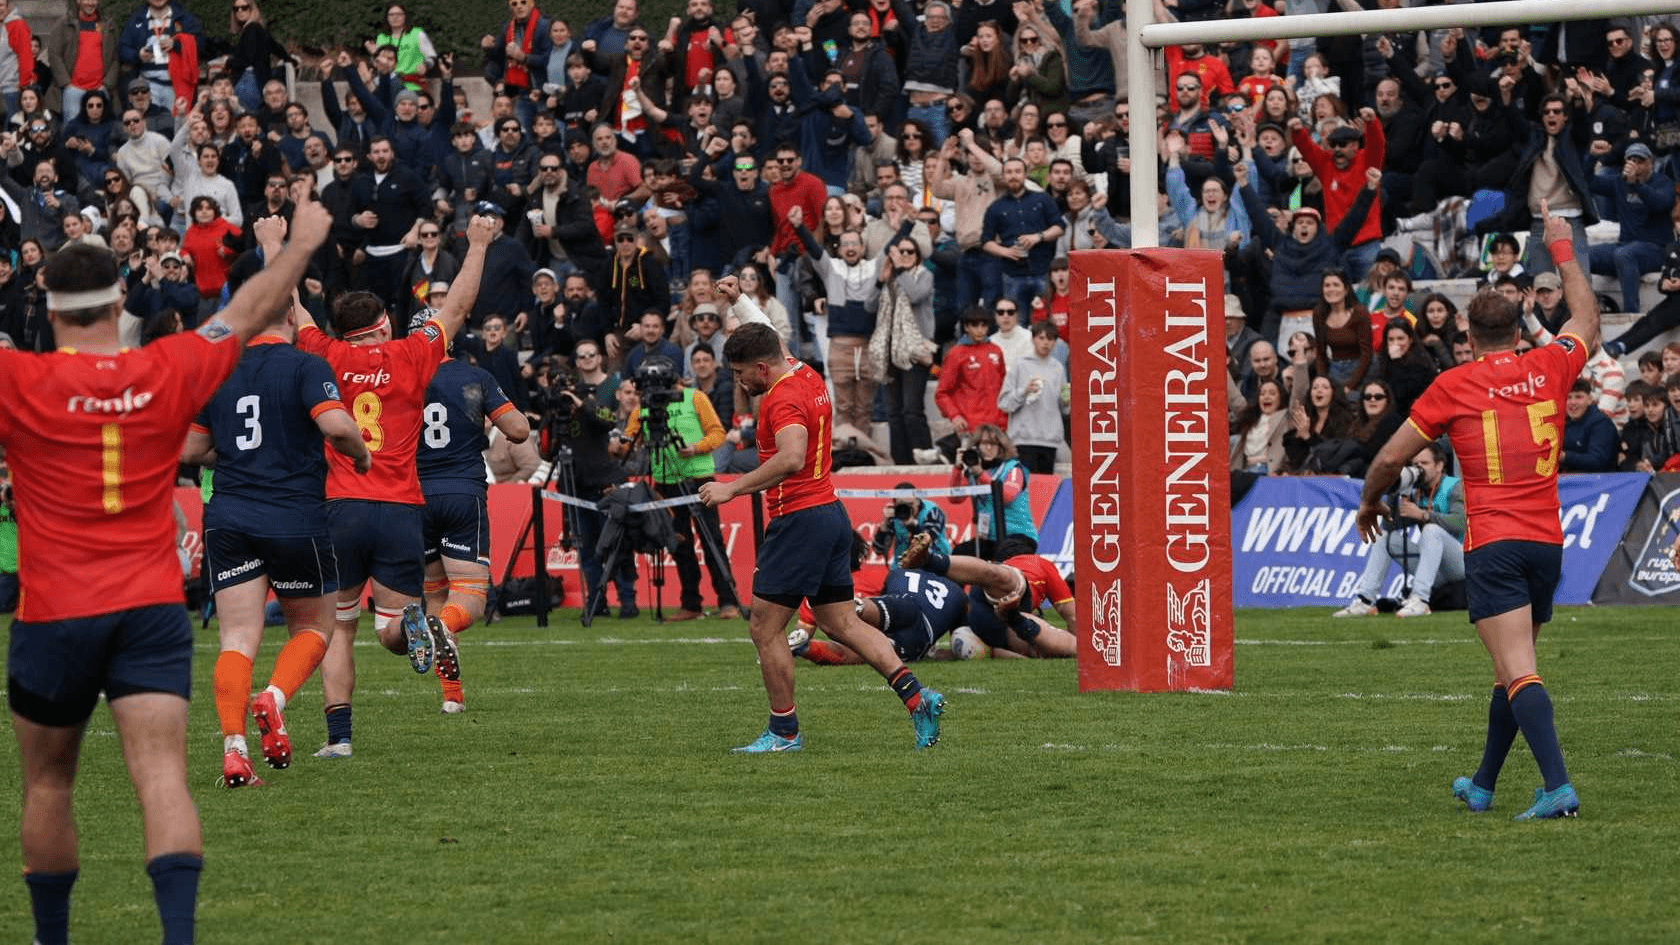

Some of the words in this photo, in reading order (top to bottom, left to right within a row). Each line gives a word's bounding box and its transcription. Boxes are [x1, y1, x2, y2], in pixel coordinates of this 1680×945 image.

[342, 368, 391, 388] renfe
[1487, 372, 1546, 399] renfe
[236, 395, 262, 450] 3
[352, 391, 384, 452] 8
[423, 402, 451, 449] 8
[1087, 276, 1121, 573] GENERALI
[1163, 276, 1210, 573] GENERALI
[1481, 399, 1558, 485] 15
[101, 421, 123, 514] 1
[904, 571, 949, 610] 13
[1251, 565, 1335, 598] OFFICIAL
